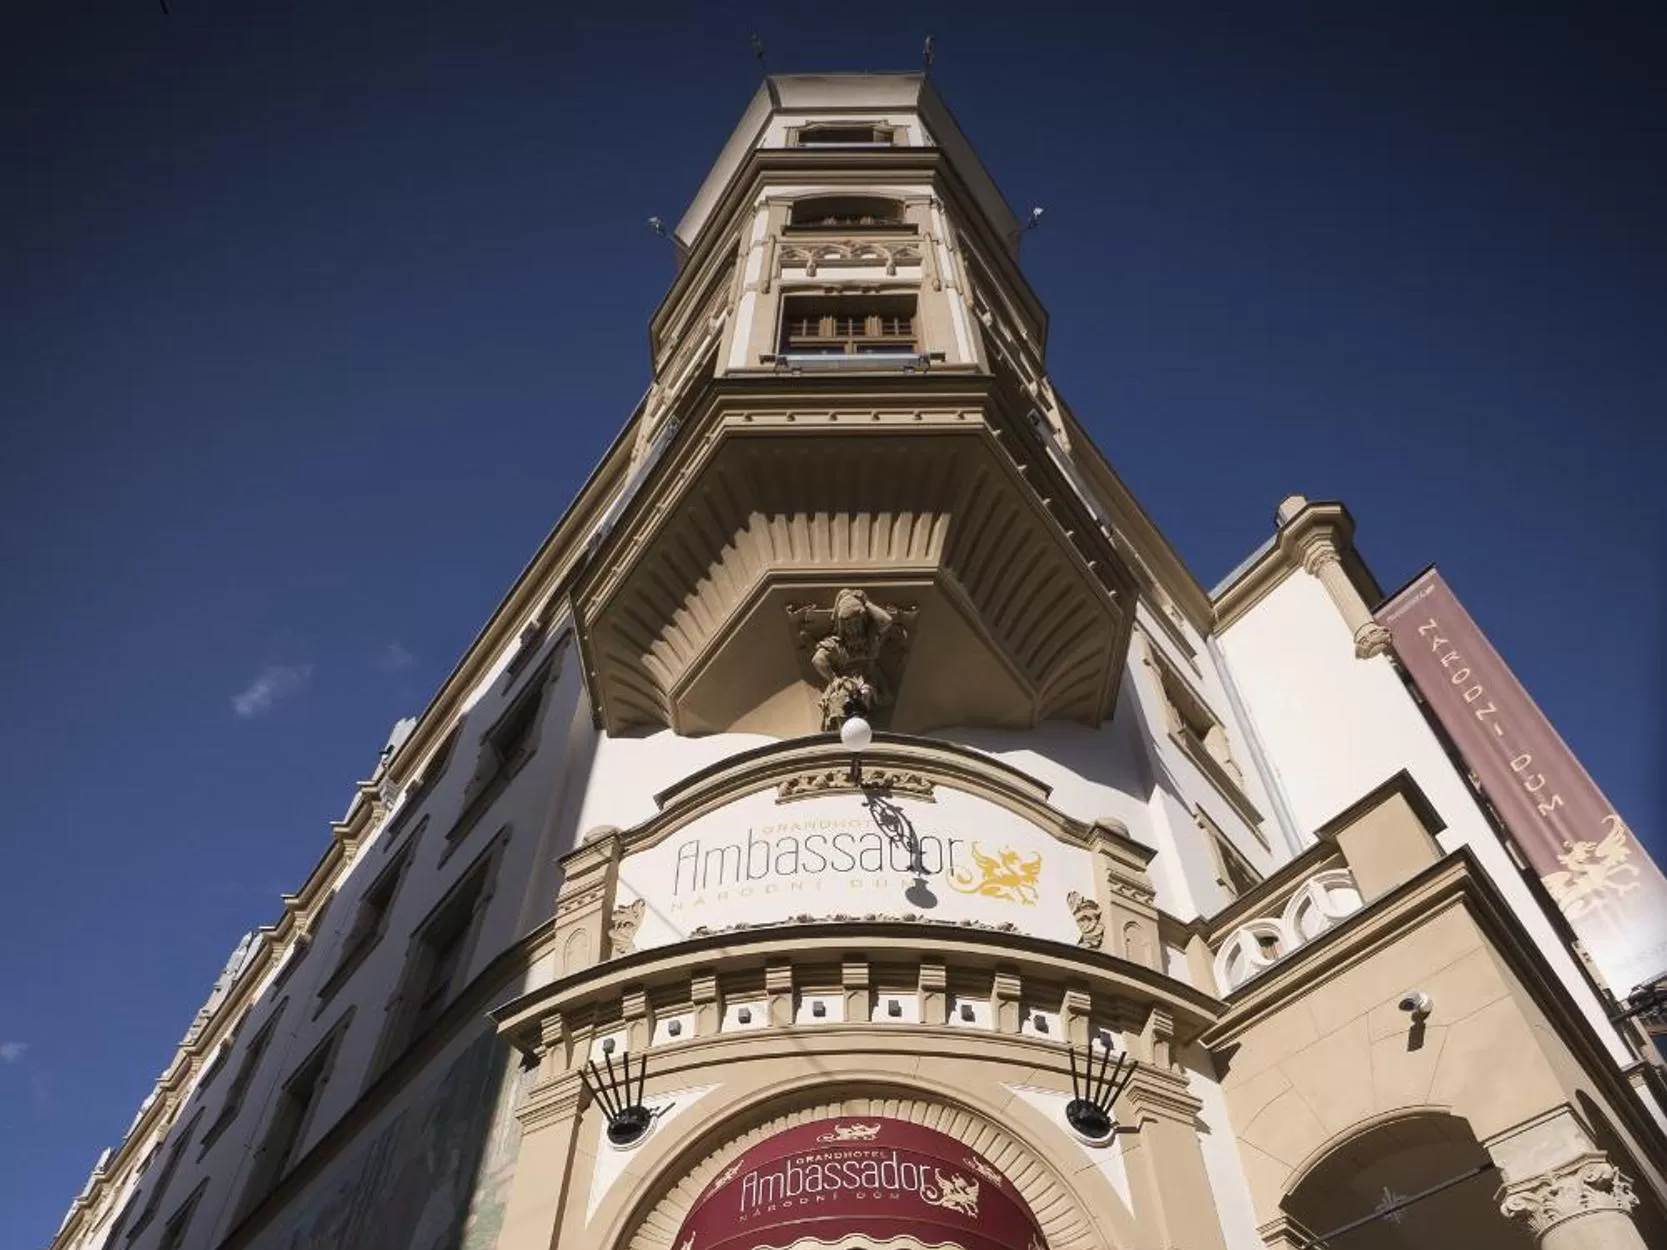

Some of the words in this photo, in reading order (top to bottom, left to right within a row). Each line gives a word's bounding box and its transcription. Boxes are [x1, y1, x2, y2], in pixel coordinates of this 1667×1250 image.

[674, 826, 963, 896] Ambassador
[740, 1151, 931, 1212] Ambassador
[796, 1151, 888, 1165] GRANDHOTEL
